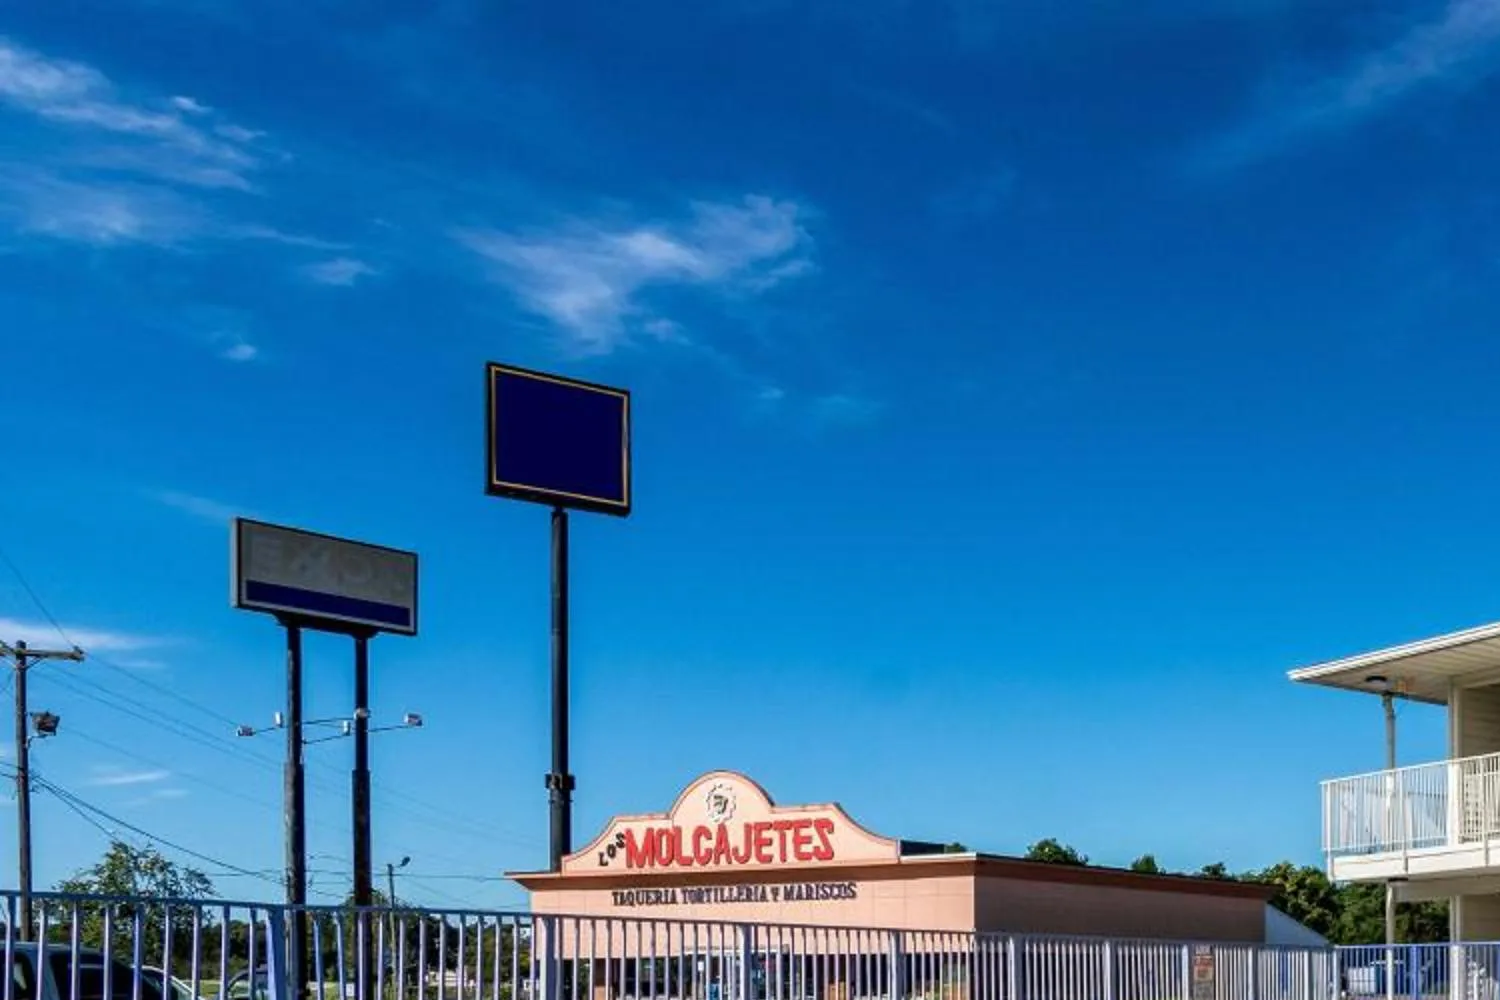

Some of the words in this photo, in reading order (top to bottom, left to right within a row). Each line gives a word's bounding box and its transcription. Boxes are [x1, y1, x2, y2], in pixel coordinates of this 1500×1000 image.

[598, 832, 627, 867] LOS
[625, 818, 835, 869] MOLCAJETES
[612, 889, 679, 907] TAQUERIA
[681, 884, 768, 904] TORTILLERIA
[783, 882, 857, 902] MARISCOS
